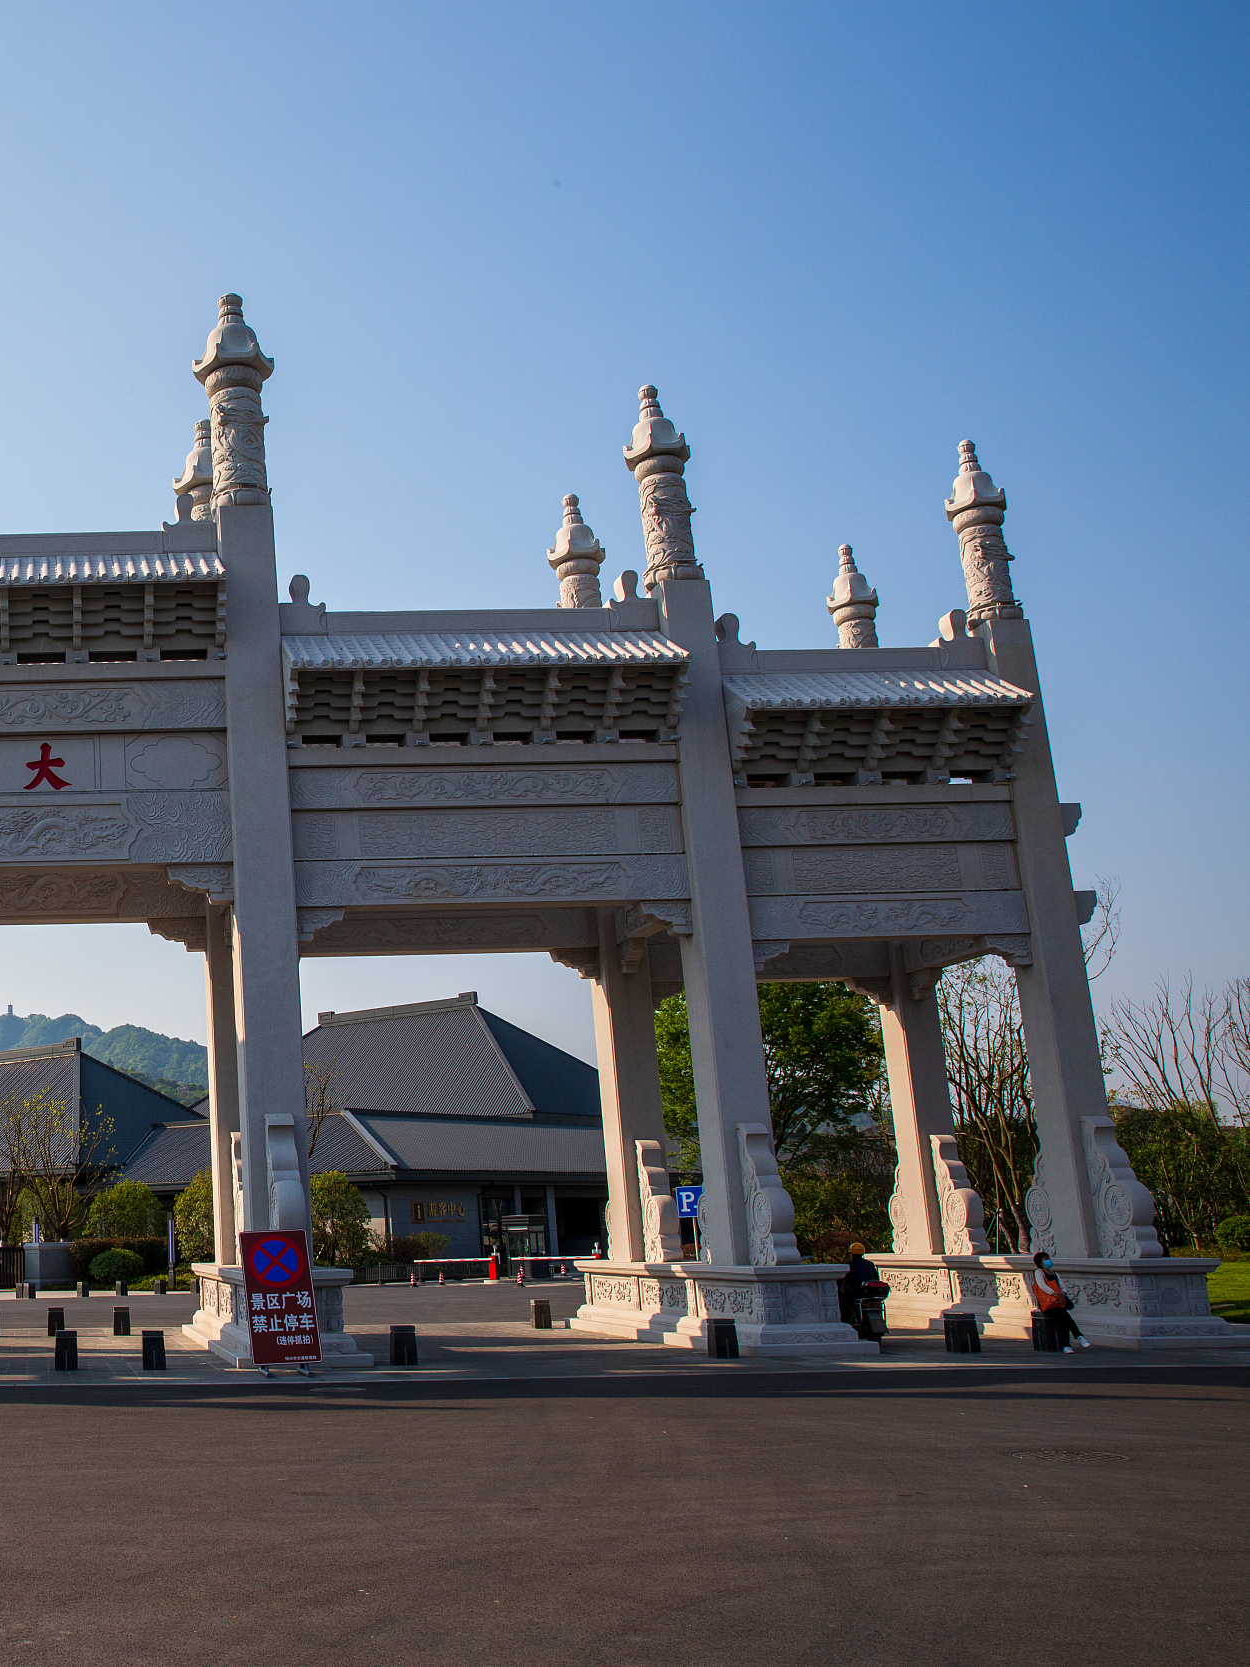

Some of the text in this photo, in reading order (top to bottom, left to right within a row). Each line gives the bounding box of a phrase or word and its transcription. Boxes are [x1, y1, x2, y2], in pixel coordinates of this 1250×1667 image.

[427, 1200, 466, 1218] 游客中心
[679, 1191, 695, 1212] P
[250, 1291, 312, 1310] 景区广场
[251, 1313, 315, 1333] 禁止停车
